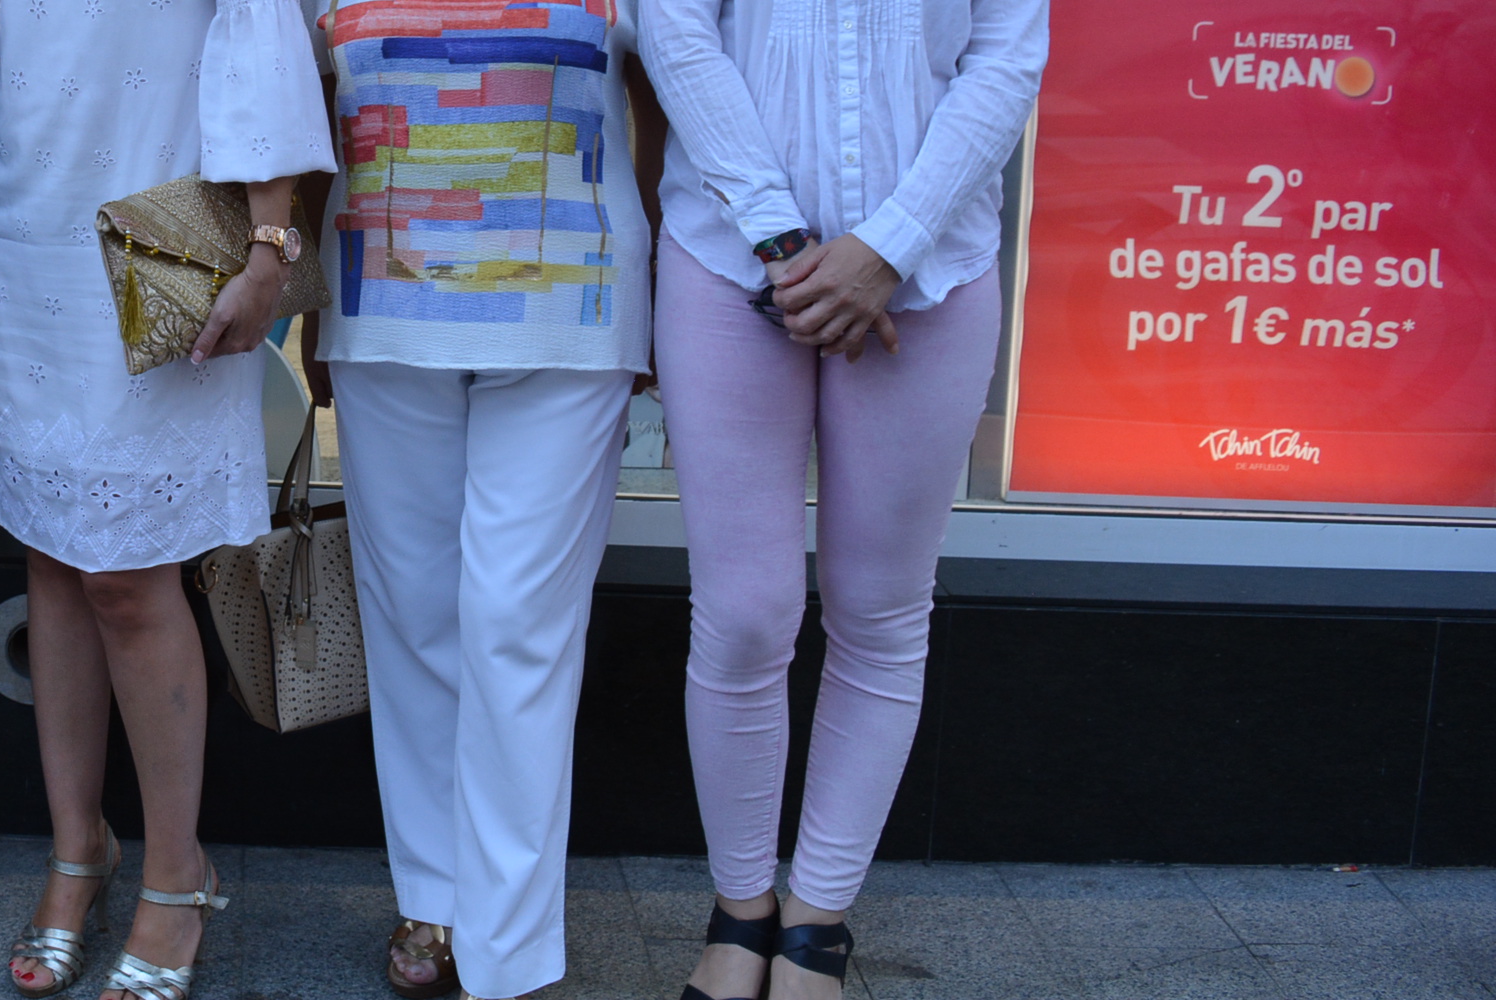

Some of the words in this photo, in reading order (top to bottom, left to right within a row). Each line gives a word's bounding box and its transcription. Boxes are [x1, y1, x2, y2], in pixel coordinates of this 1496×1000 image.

[1234, 32, 1256, 48] LA
[1259, 32, 1319, 50] FIESTA
[1321, 34, 1354, 51] DEL
[1172, 184, 1226, 226] Tu
[1310, 200, 1394, 240] par
[1108, 238, 1164, 280] de
[1175, 241, 1297, 291] gafas
[1307, 244, 1362, 288] de
[1373, 248, 1444, 290] sol
[1126, 309, 1208, 351] por
[1235, 462, 1247, 470] DE
[1248, 463, 1290, 472] AFFLELOU
